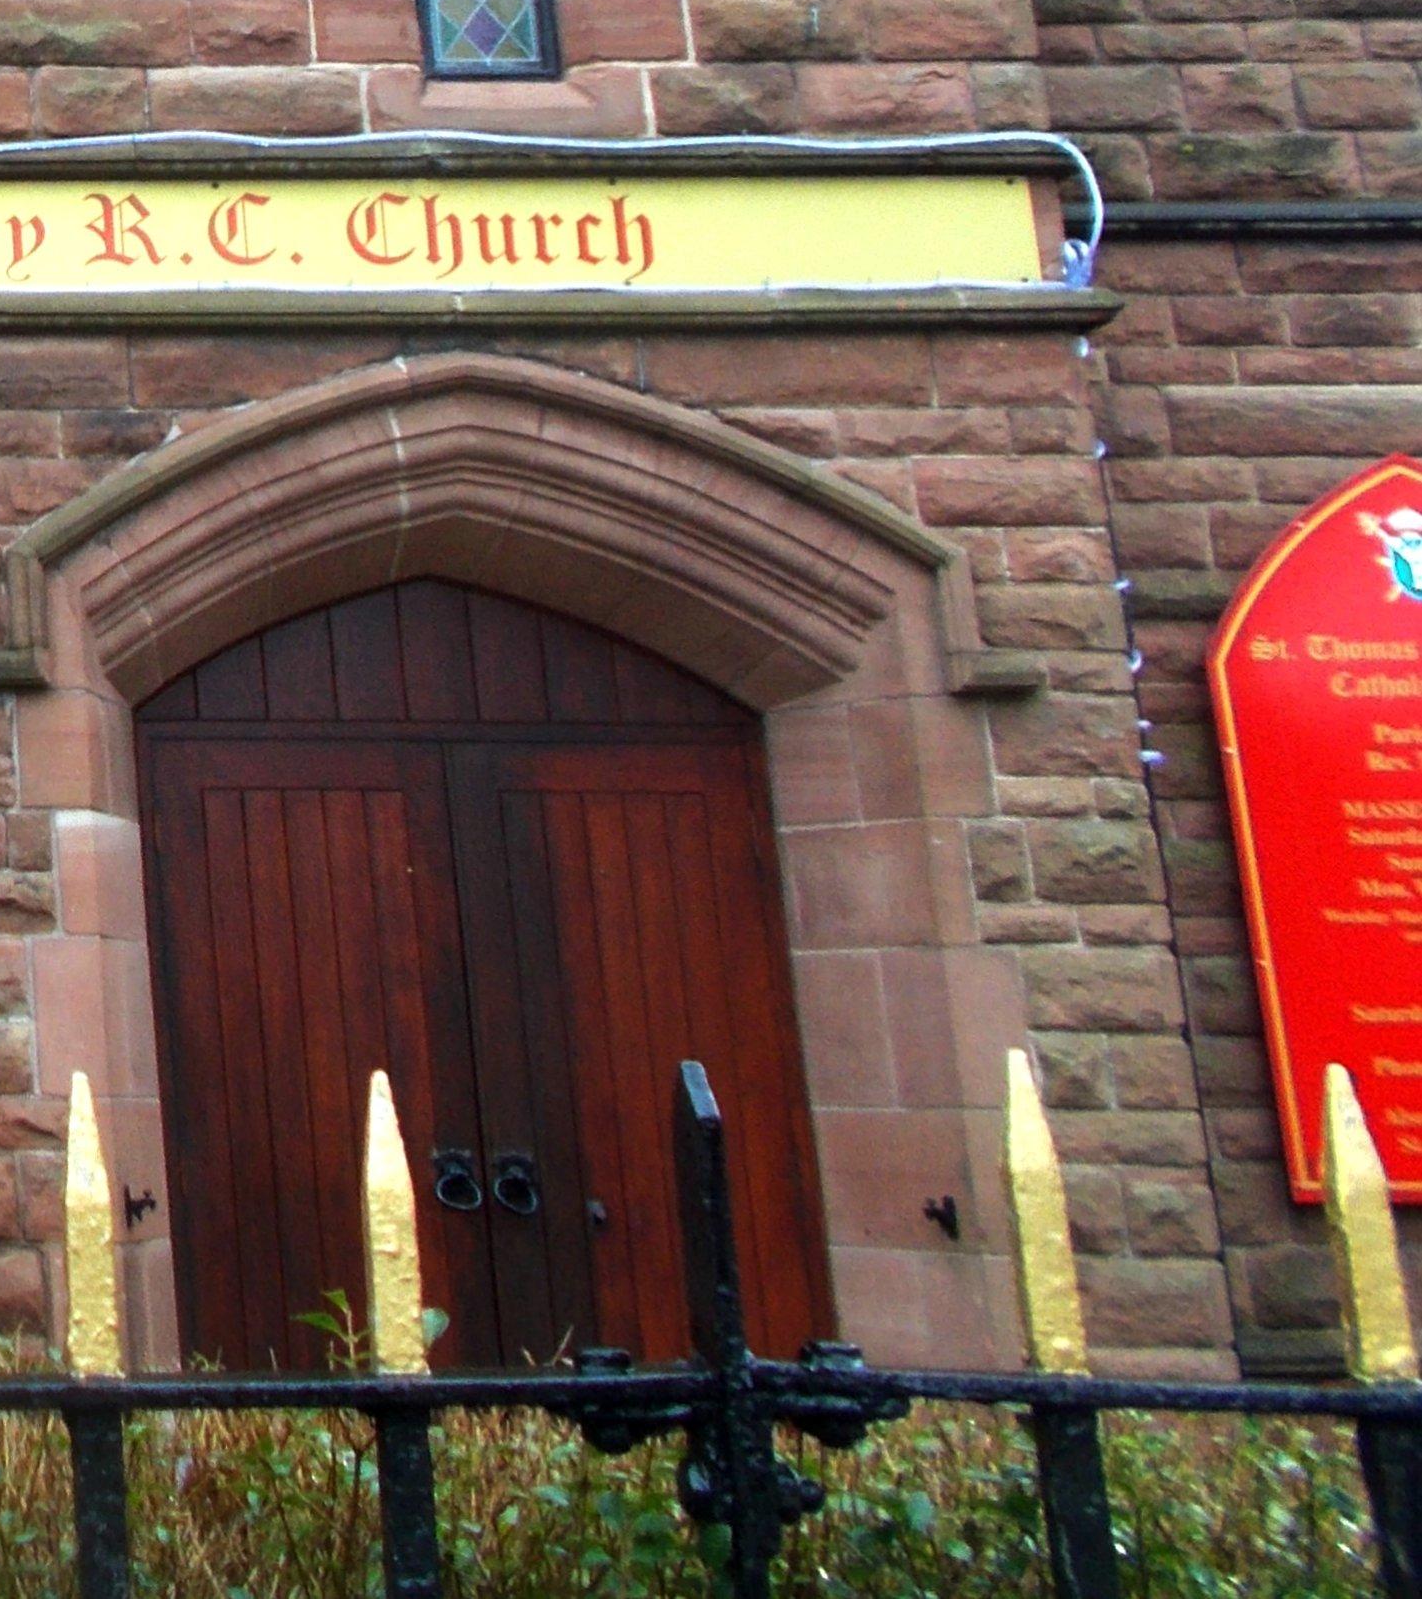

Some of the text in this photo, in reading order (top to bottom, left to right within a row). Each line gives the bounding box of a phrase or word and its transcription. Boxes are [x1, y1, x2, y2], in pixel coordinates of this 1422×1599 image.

[84, 191, 303, 268] R.C.
[346, 191, 655, 280] Church
[1308, 634, 1419, 662] Thomas
[1331, 671, 1422, 698] Cathol
